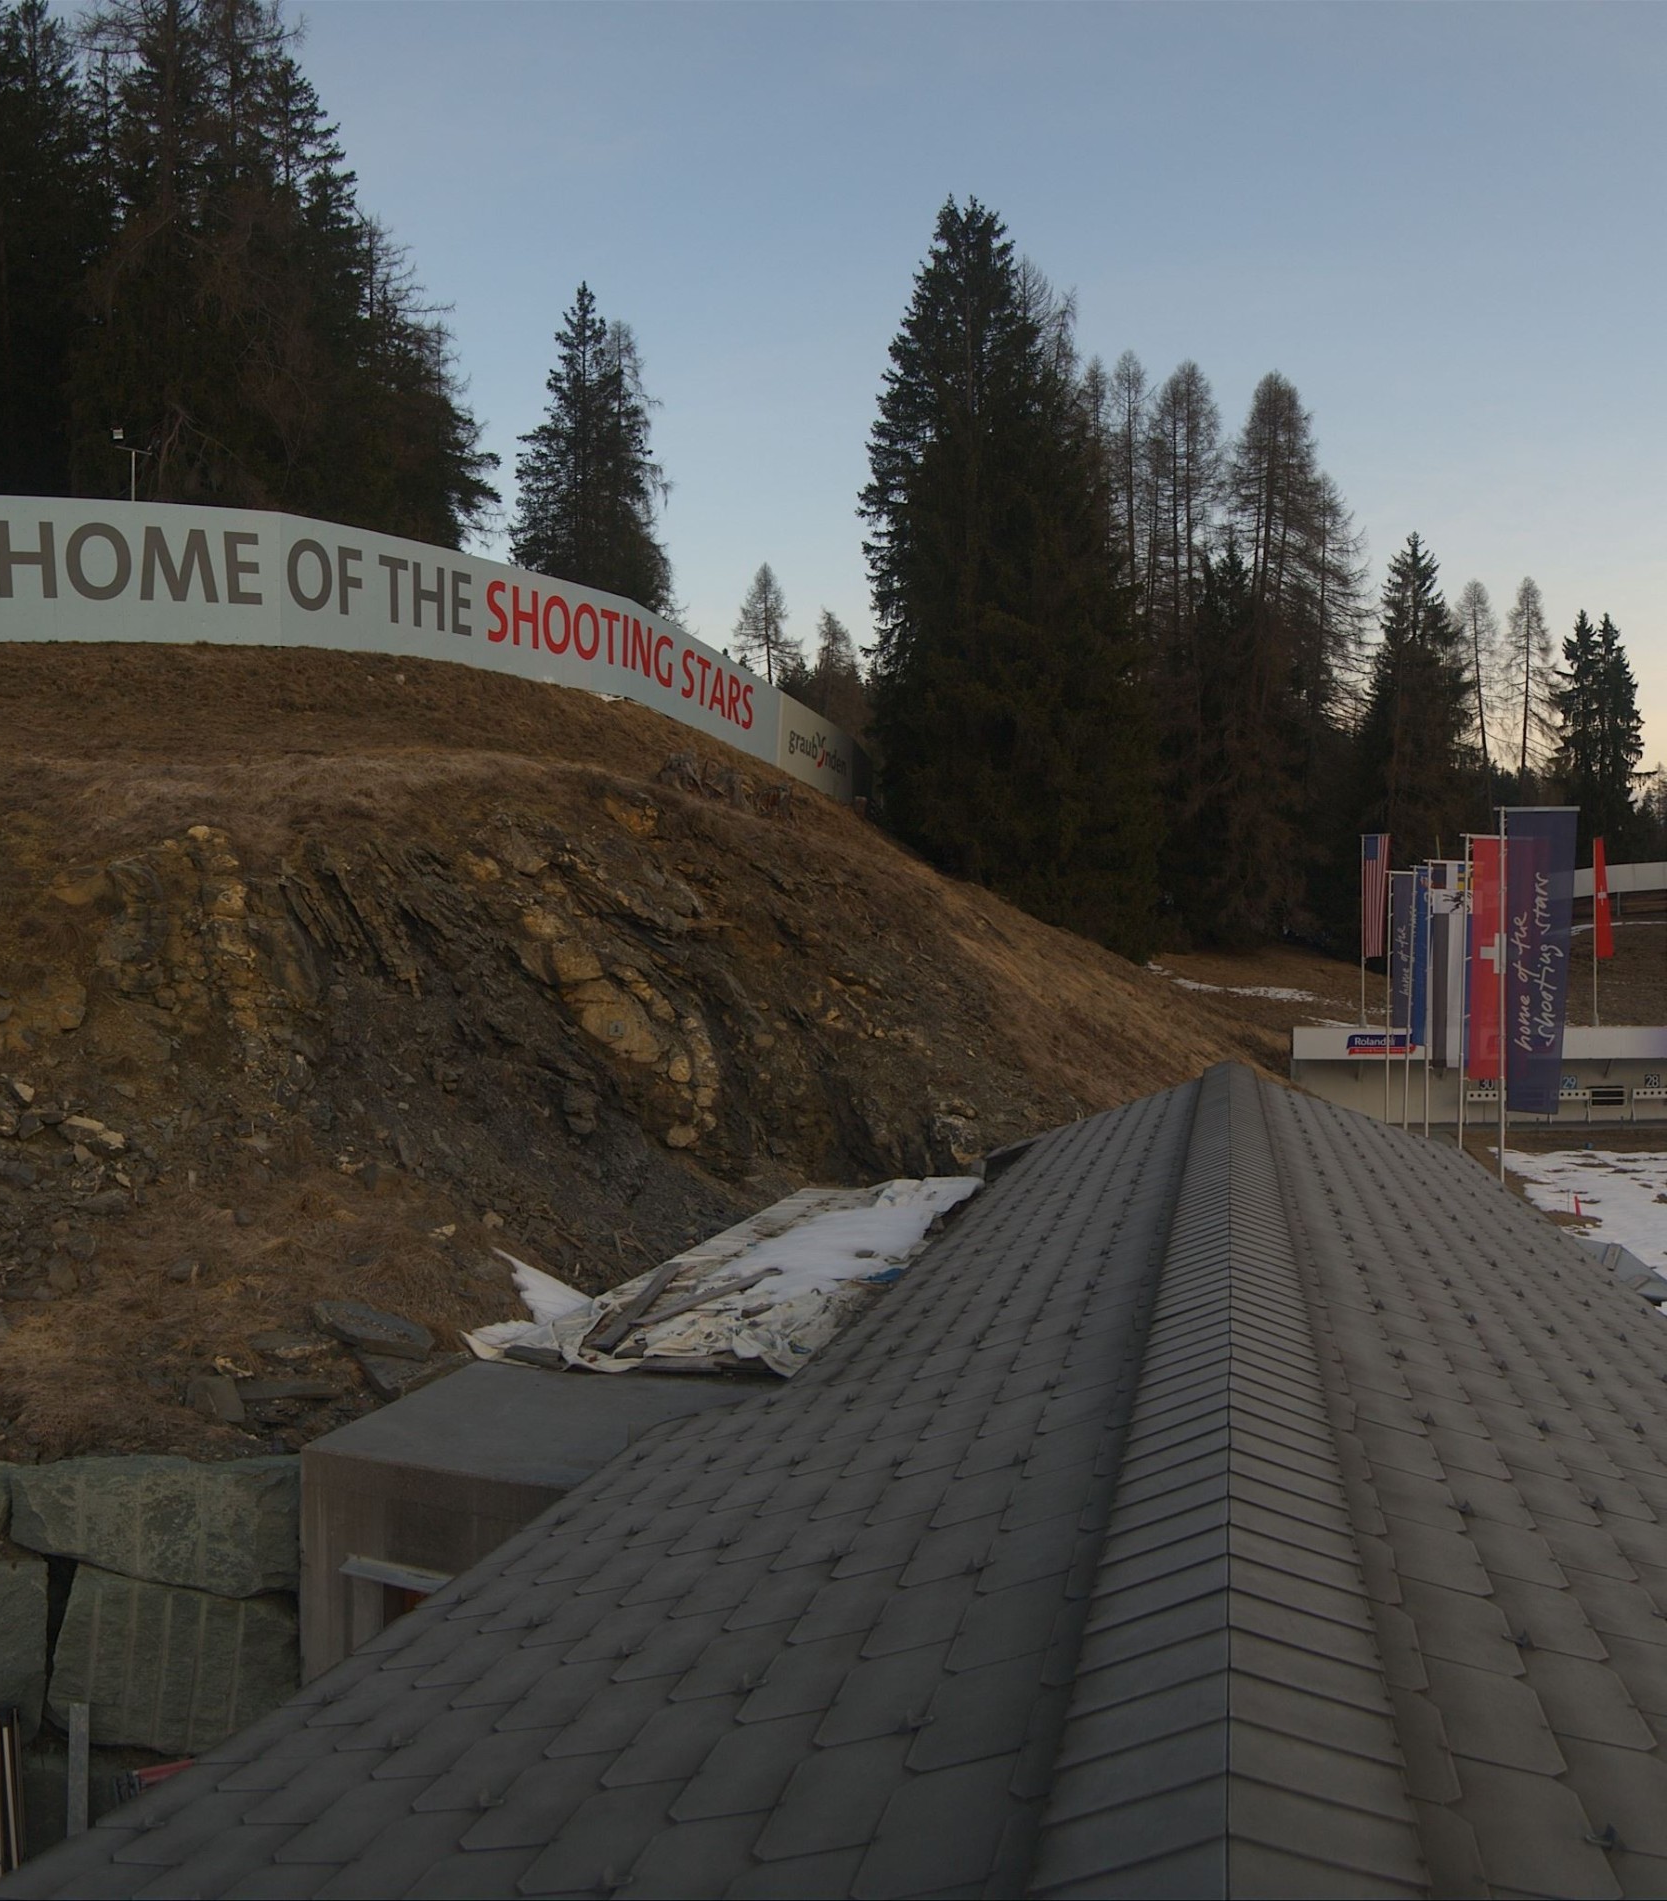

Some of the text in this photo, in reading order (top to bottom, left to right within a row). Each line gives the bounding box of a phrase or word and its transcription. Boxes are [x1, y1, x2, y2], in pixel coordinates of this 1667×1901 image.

[287, 538, 363, 615] OF
[378, 553, 472, 637] THE
[486, 580, 674, 688] SHOOTING
[681, 648, 754, 730] STARS
[1509, 911, 1540, 1052] home of the
[1533, 943, 1565, 1048] shooting
[1354, 1037, 1387, 1046] Roland
[1480, 1079, 1493, 1089] 30
[1563, 1076, 1576, 1089] 29
[1646, 1075, 1659, 1088] 28
